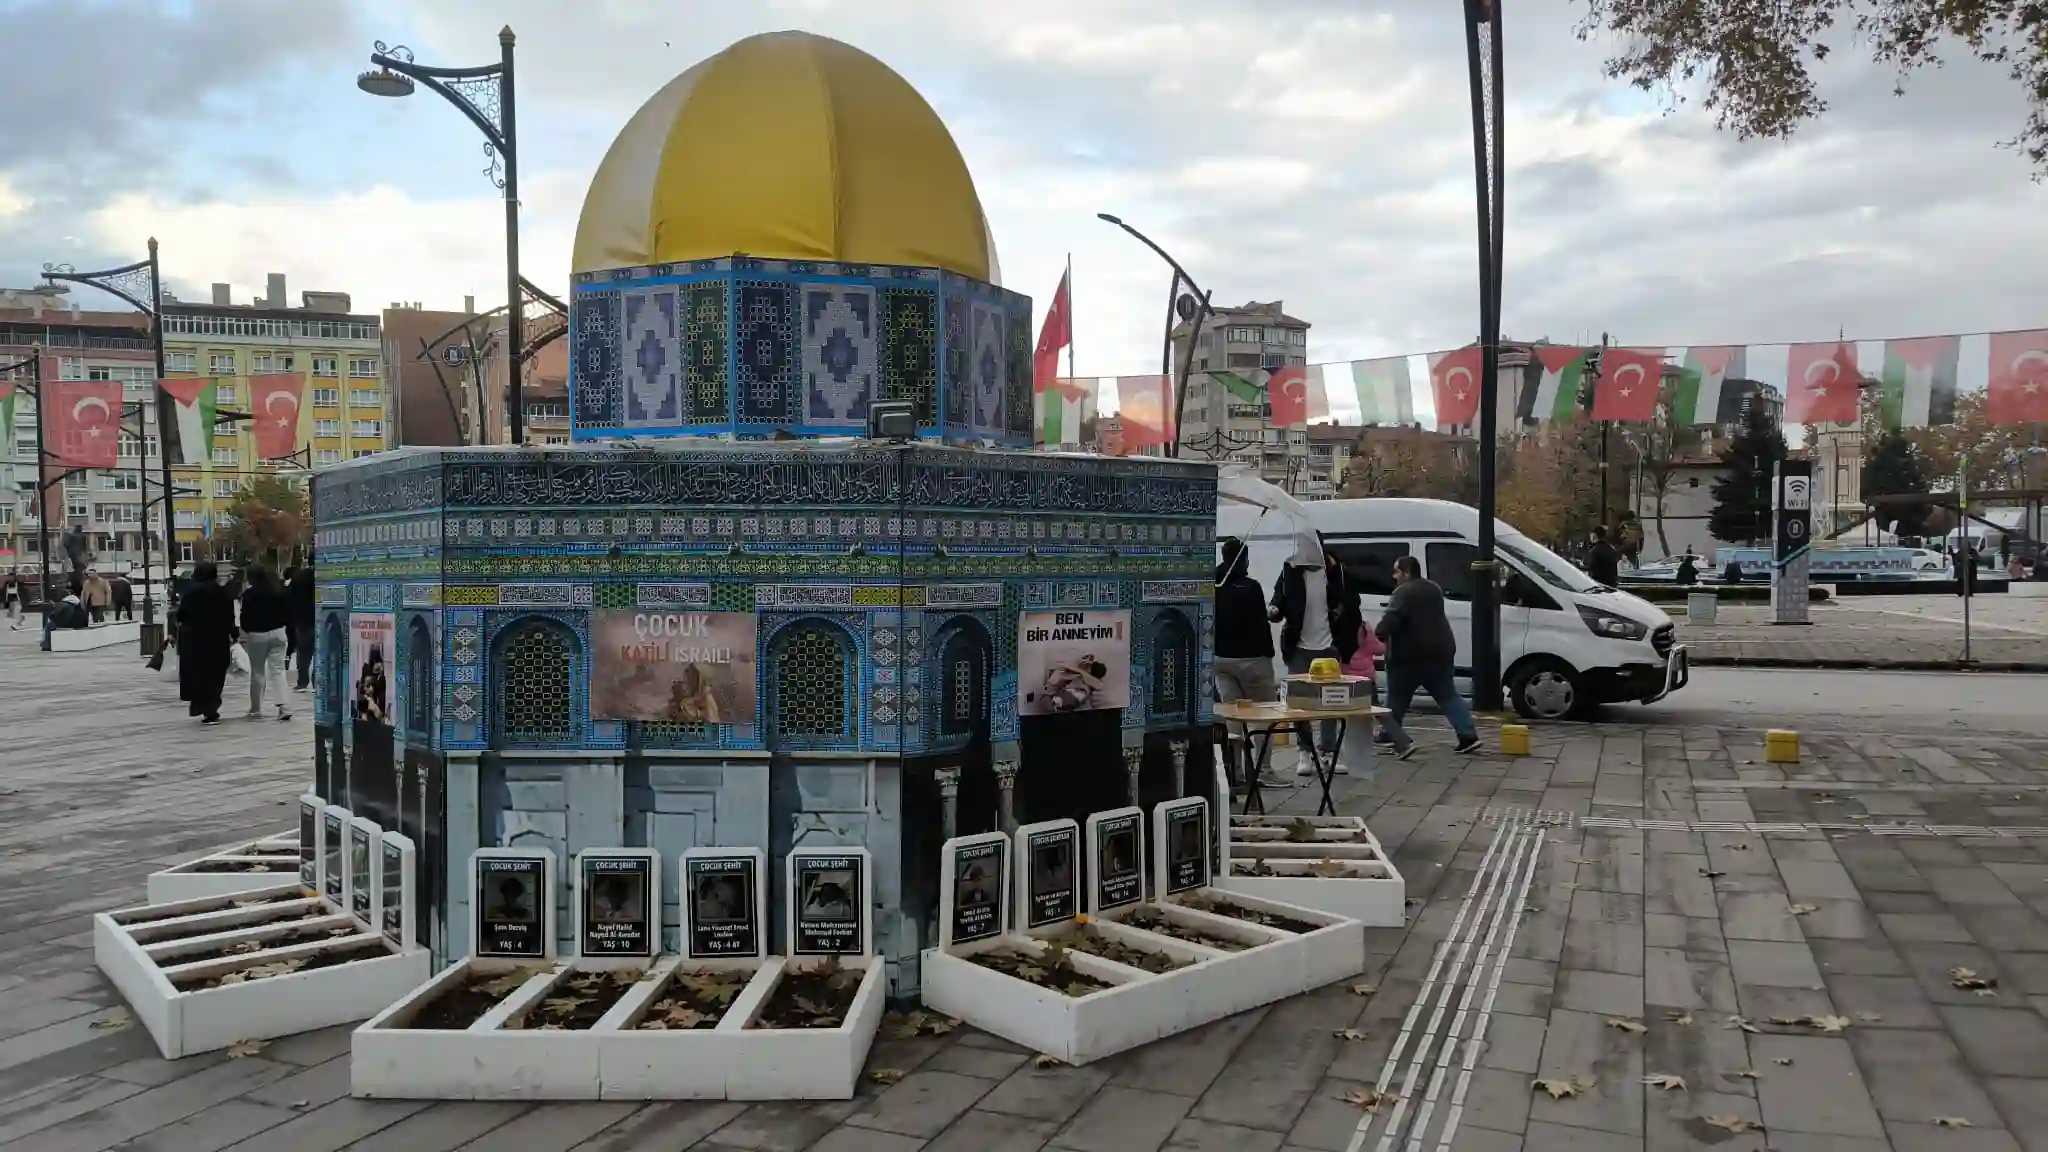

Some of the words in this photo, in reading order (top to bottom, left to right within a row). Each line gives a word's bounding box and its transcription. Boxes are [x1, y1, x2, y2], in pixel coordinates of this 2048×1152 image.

[1055, 612, 1084, 625] BEN
[634, 613, 709, 642] ÇOCUK
[1027, 626, 1049, 642] BİR
[490, 862, 512, 872] ÇOCUK
[512, 861, 532, 871] ŞEHİT
[595, 861, 618, 871] ÇOCUK
[618, 860, 637, 871] ŞEHİT
[700, 862, 723, 872] ÇOCUK
[723, 861, 742, 871] ŞEHİT
[807, 860, 829, 869] ÇOCUK
[829, 859, 849, 869] ŞEHİT
[499, 940, 513, 951] YAŞ
[603, 940, 616, 950] YAŞ
[621, 940, 630, 949] 10
[708, 940, 722, 950] YAŞ
[817, 938, 830, 948] YAŞ
[835, 938, 841, 947] 2
